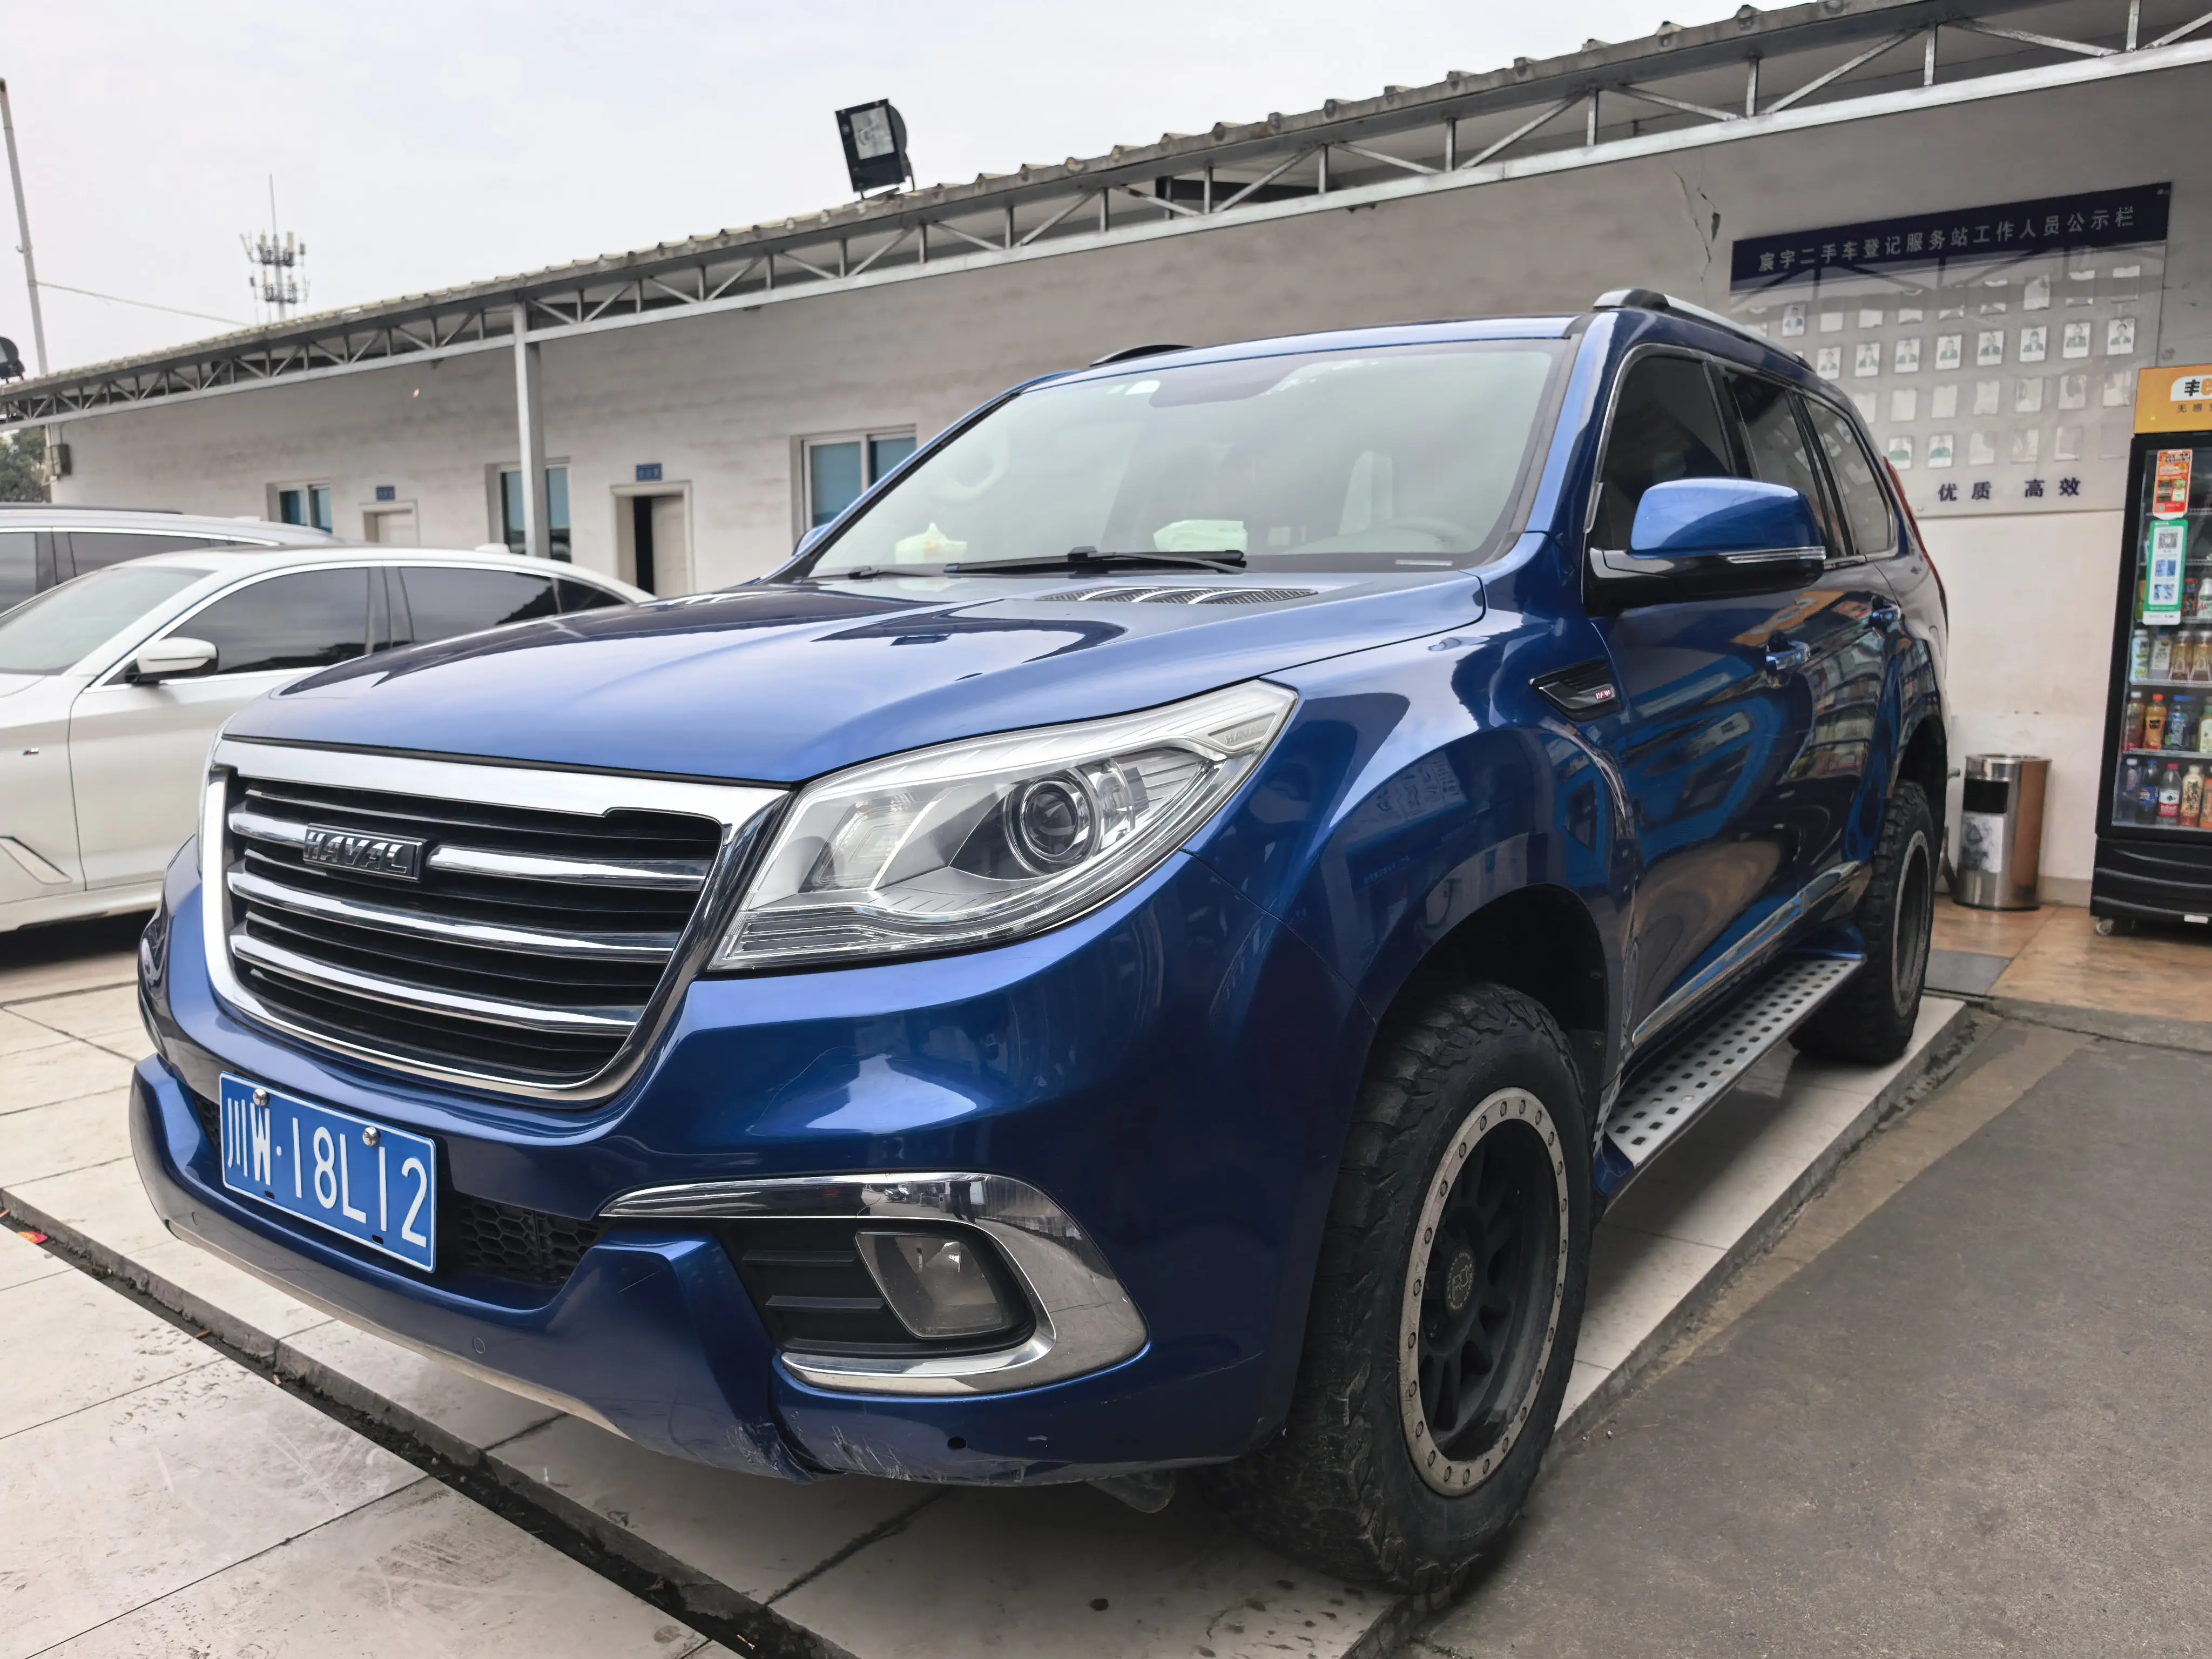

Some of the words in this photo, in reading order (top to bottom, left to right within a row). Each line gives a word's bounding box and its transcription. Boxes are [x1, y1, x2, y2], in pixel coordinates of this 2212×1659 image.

[1938, 481, 1991, 502] 优质
[2025, 477, 2080, 497] 高效
[304, 832, 407, 873] HAVAL
